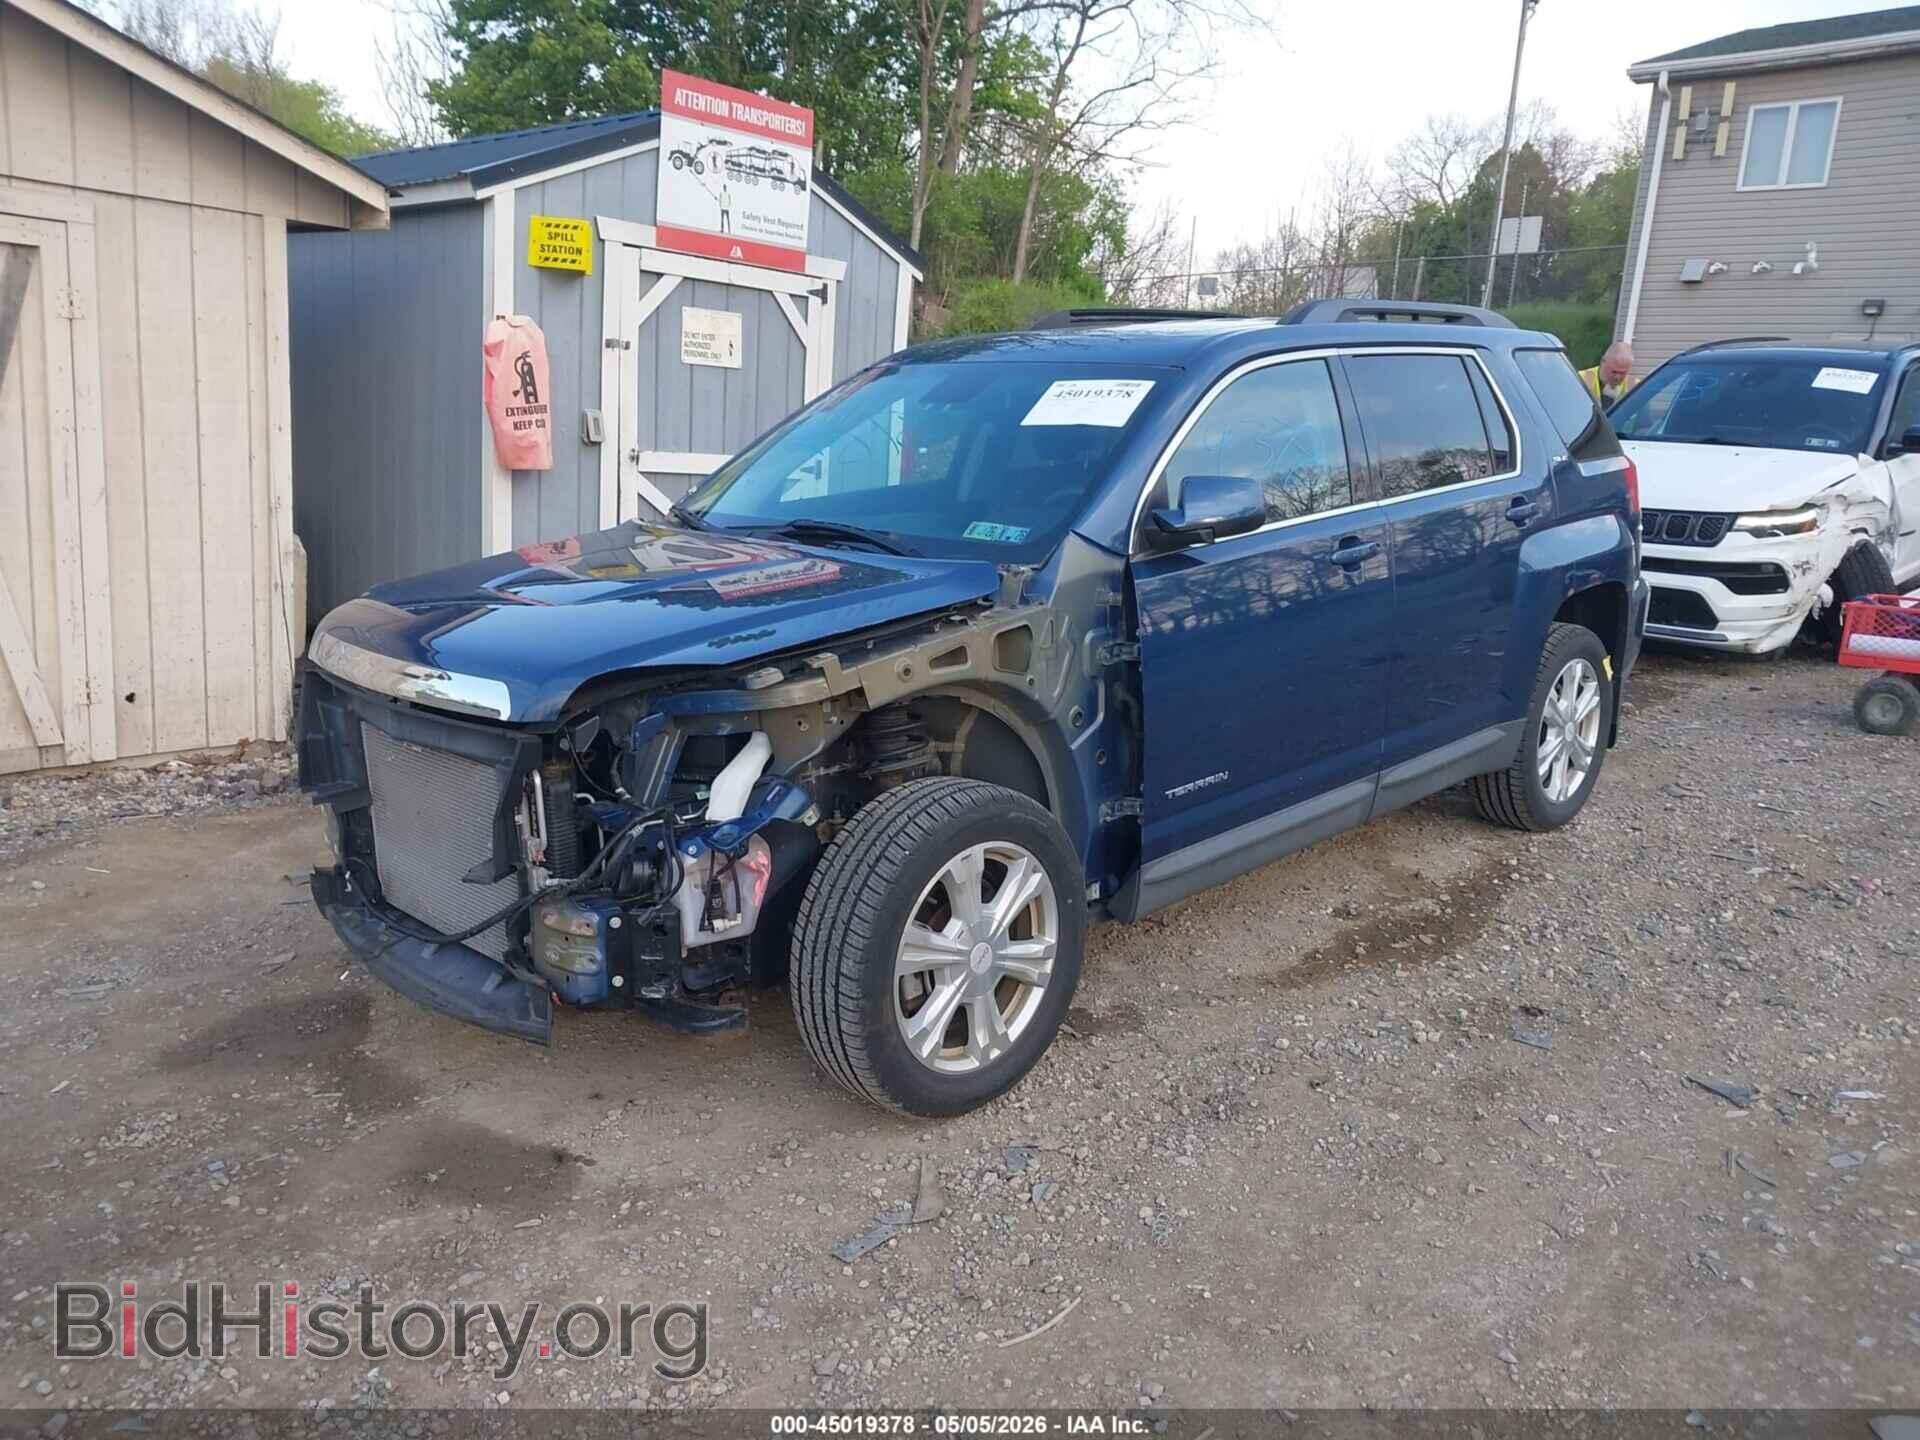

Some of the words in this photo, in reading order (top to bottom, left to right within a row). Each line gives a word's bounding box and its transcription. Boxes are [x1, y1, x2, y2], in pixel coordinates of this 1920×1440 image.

[675, 88, 729, 117] ATTENTION
[731, 102, 806, 137] TRANSPORTERS!
[742, 210, 761, 225] Safety
[777, 217, 804, 231] Required
[547, 231, 576, 242] SPILL
[539, 244, 583, 256] STATION
[1052, 389, 1135, 399] 45019378
[513, 420, 533, 431] KEEP
[1165, 771, 1228, 799] TERRAIN
